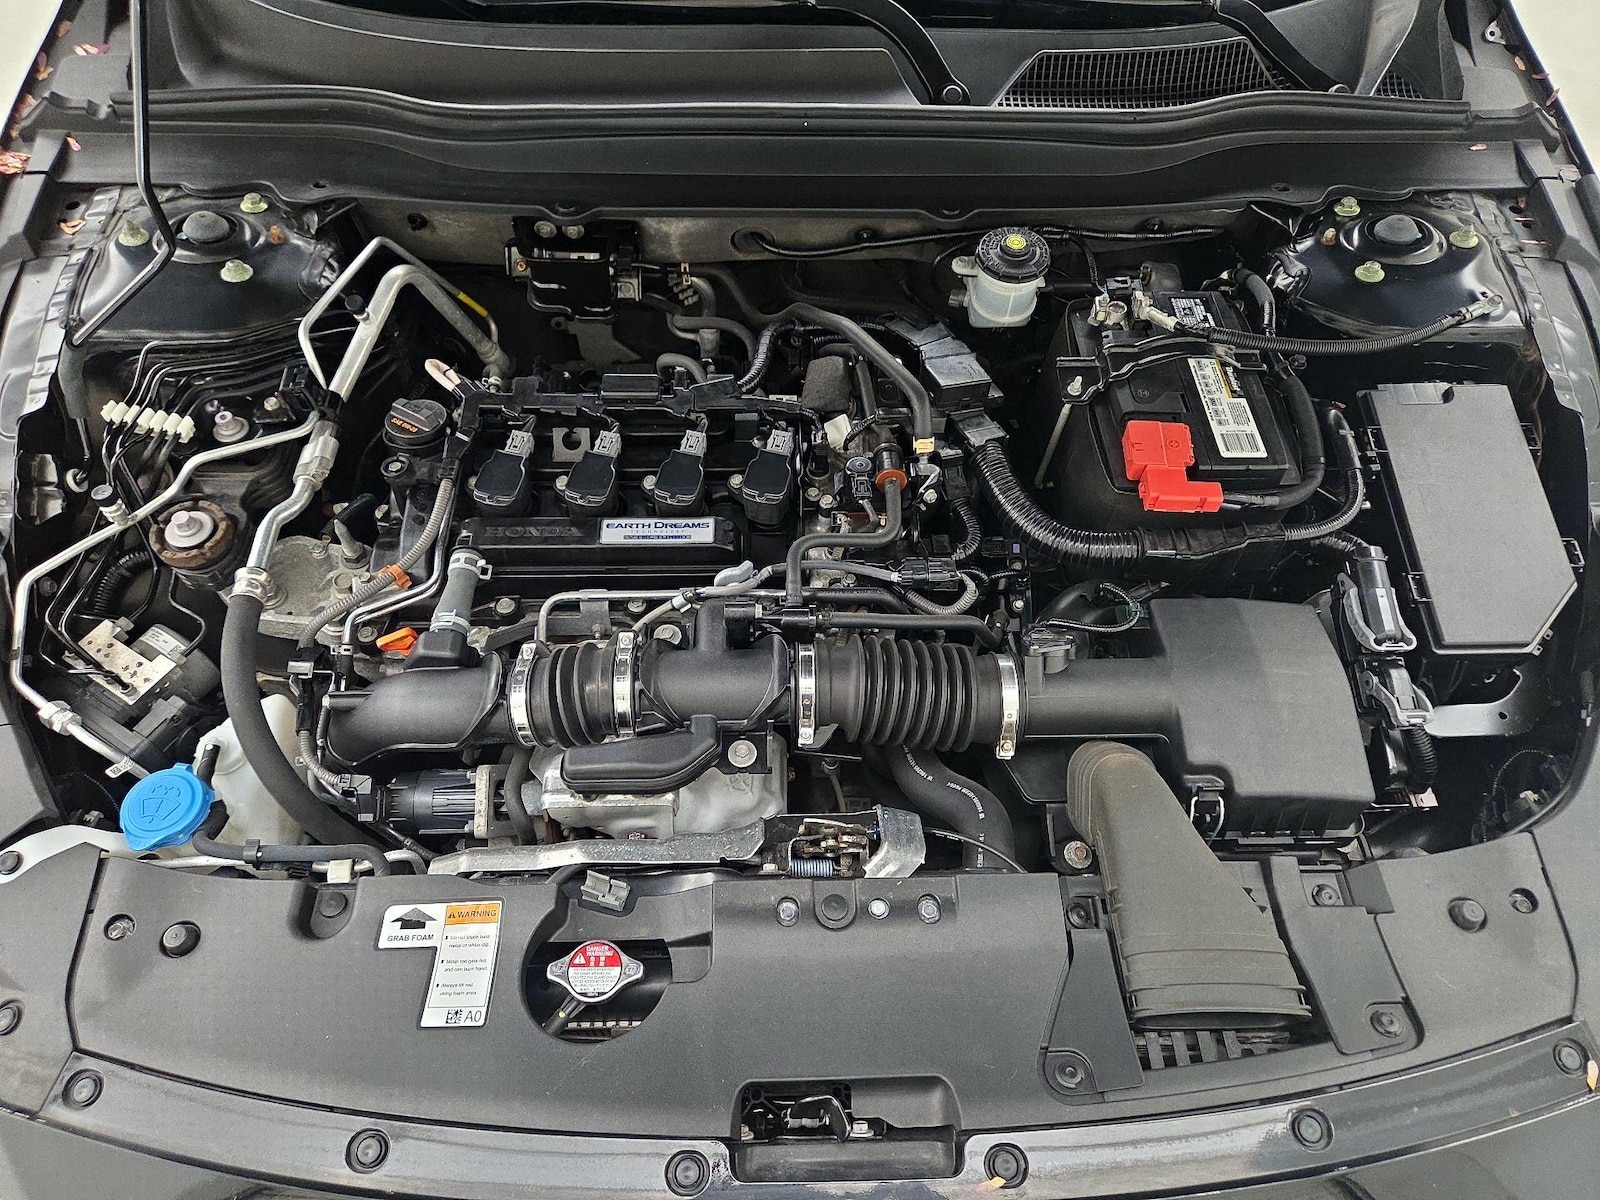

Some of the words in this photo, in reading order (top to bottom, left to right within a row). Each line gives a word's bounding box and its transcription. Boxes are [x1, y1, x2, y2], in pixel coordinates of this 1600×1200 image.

[654, 521, 710, 529] DREAMS
[485, 526, 584, 537] HONDA
[457, 909, 497, 918] WARNING
[463, 1010, 482, 1022] A0
